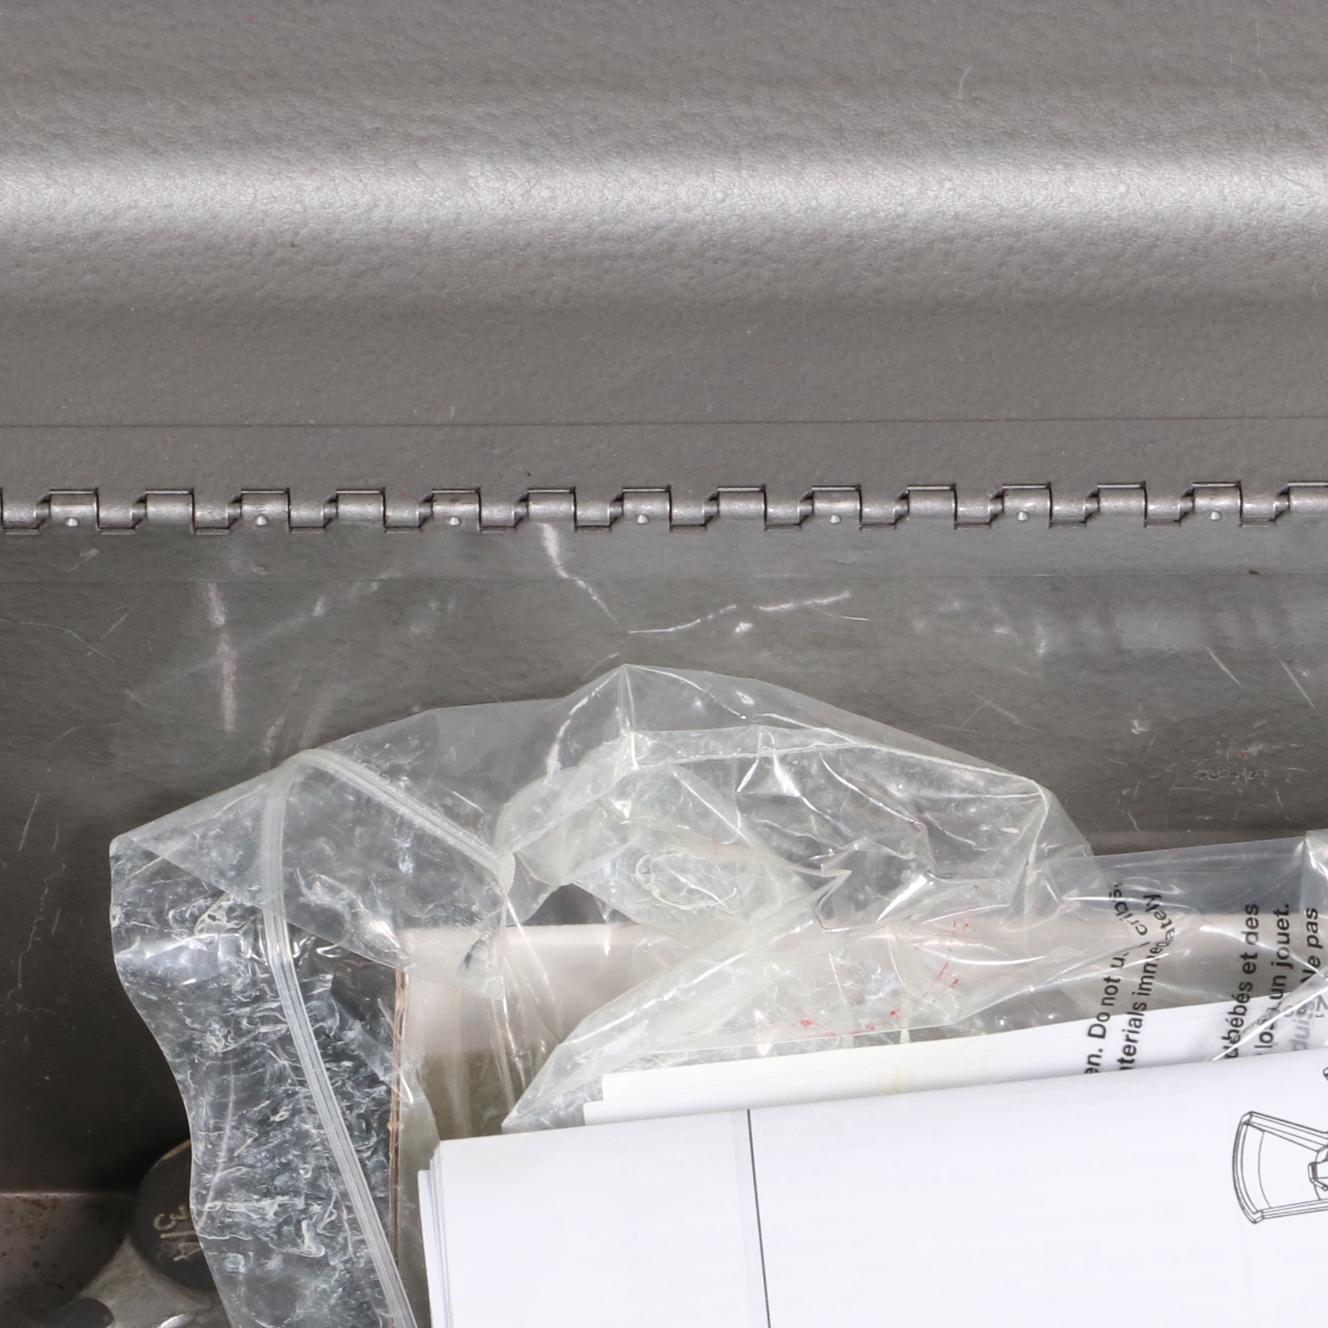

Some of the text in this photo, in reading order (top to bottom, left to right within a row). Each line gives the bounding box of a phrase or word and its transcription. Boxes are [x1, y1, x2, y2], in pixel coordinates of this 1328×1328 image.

[1244, 903, 1260, 943] des
[1305, 907, 1323, 952] pas
[1243, 952, 1258, 973] et
[1270, 903, 1291, 1000] un jouet.
[1088, 1011, 1110, 1040] Do
[1101, 975, 1120, 1007] not
